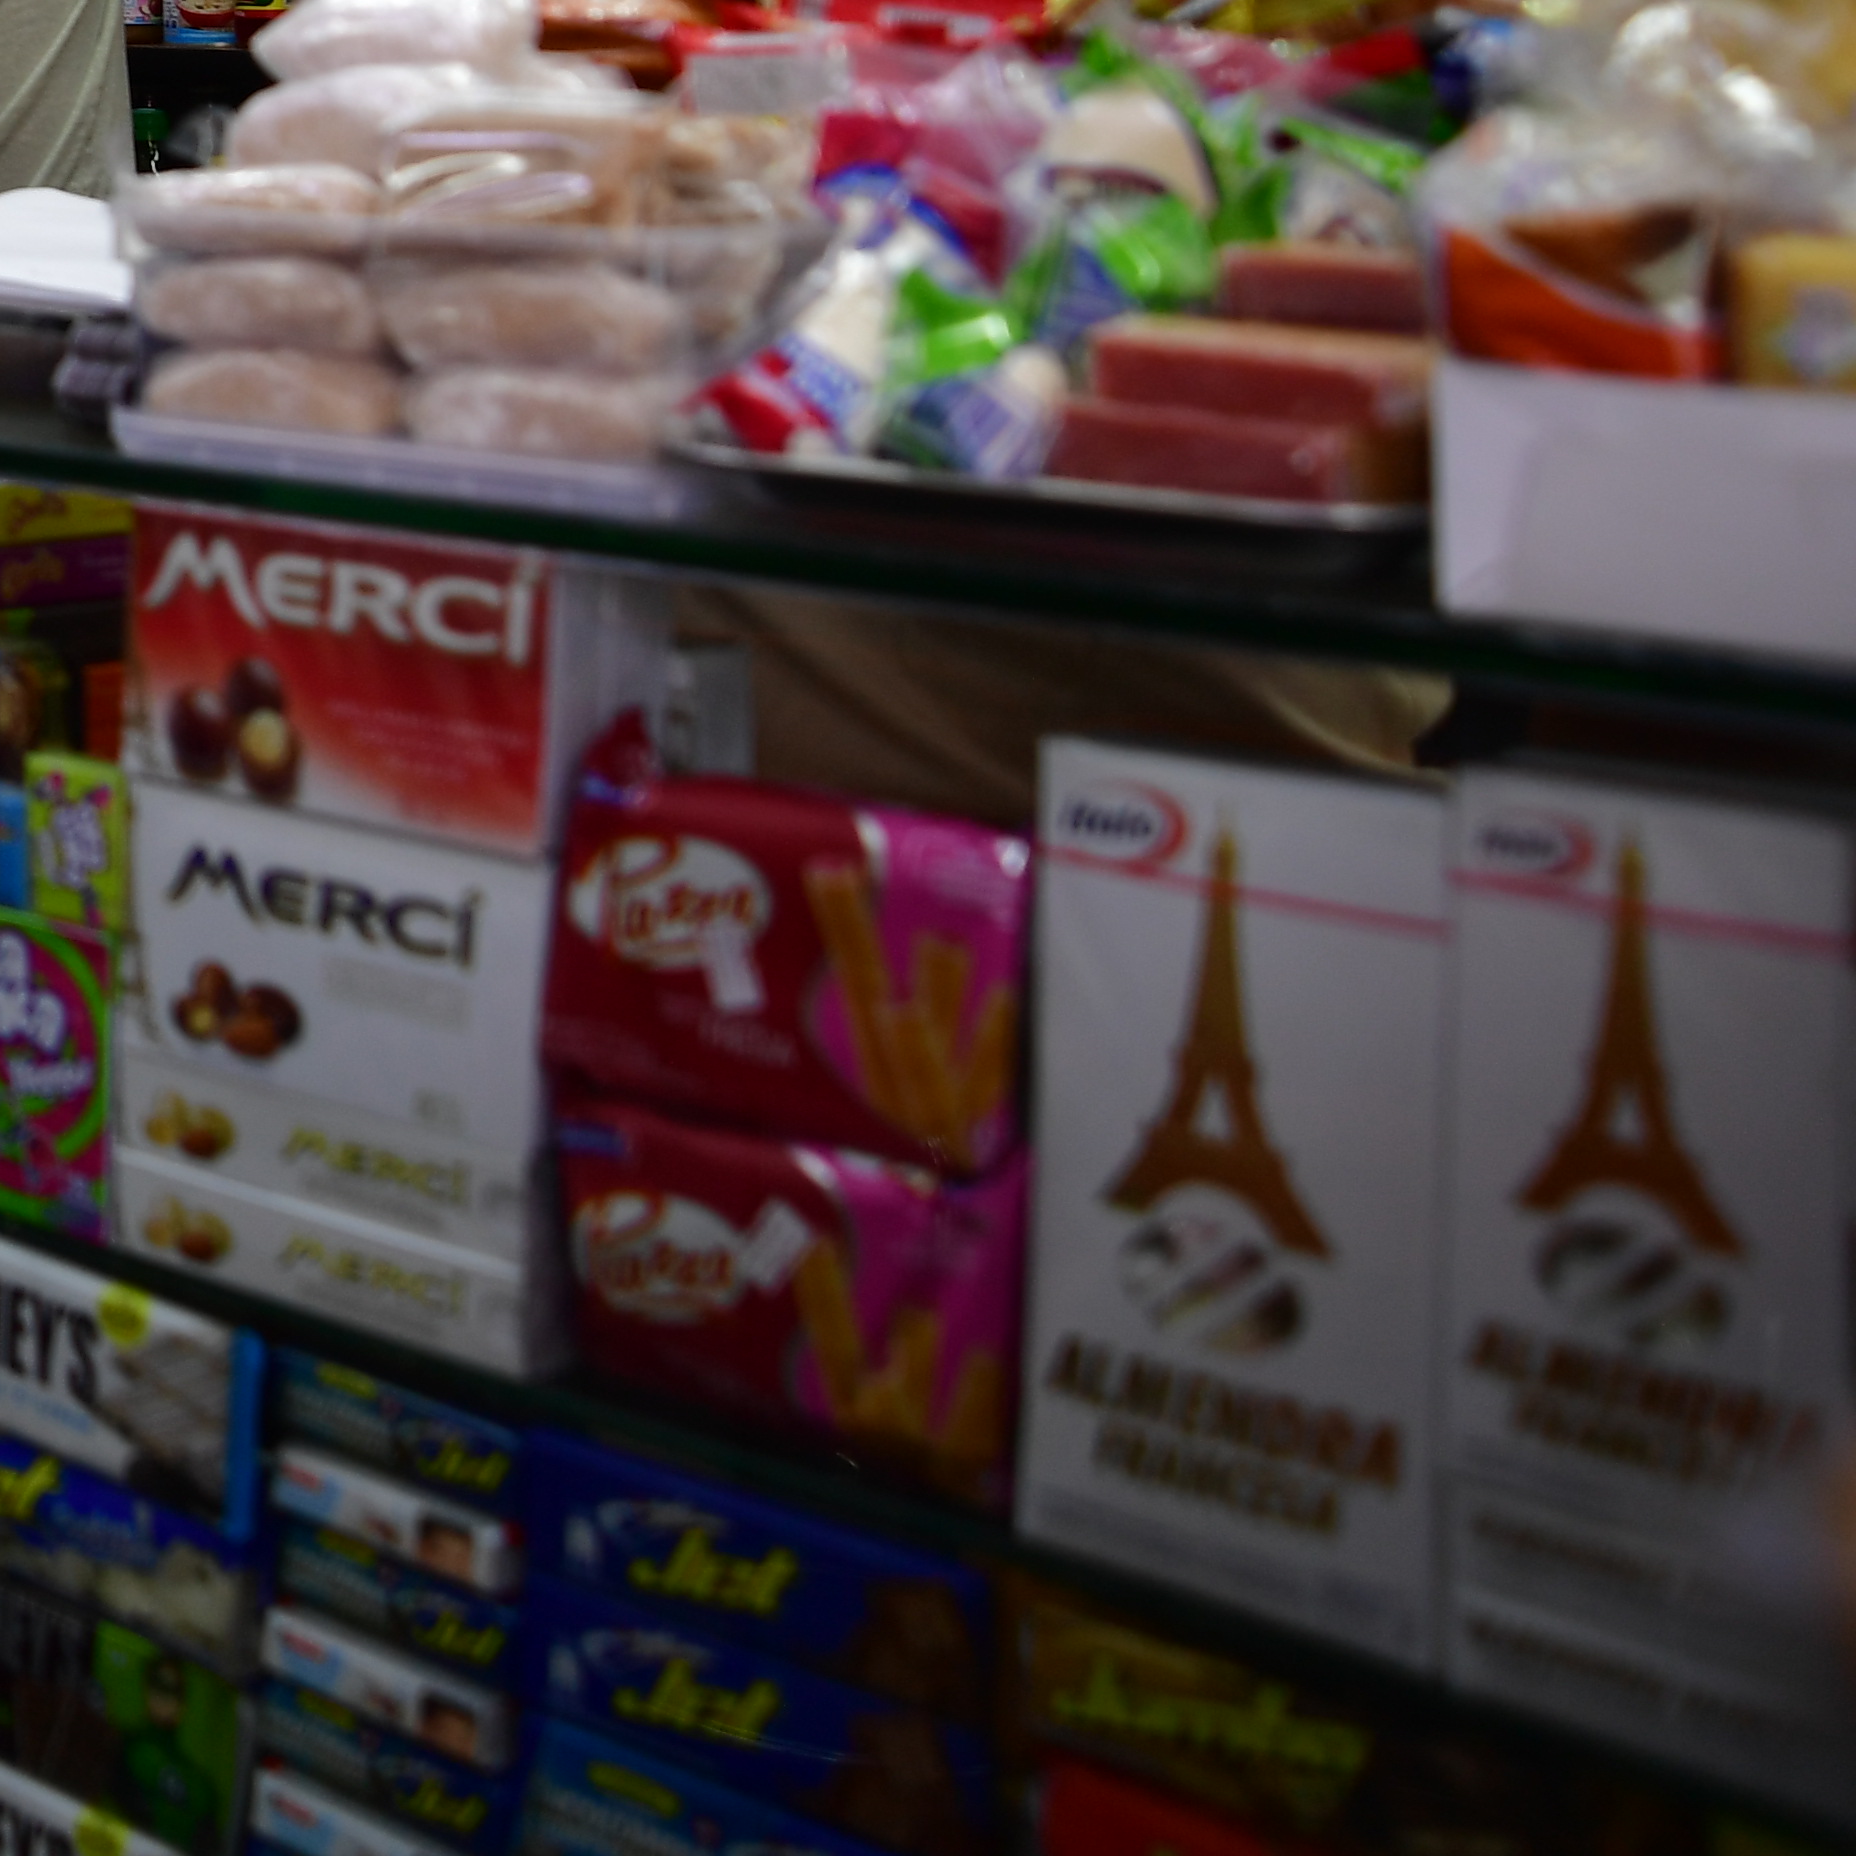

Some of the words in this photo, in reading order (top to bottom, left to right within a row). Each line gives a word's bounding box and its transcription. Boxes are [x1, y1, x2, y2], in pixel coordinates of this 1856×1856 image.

[143, 528, 543, 668] MERCI
[167, 842, 485, 968] MERCI
[1048, 1334, 1405, 1492] ALMENDRA
